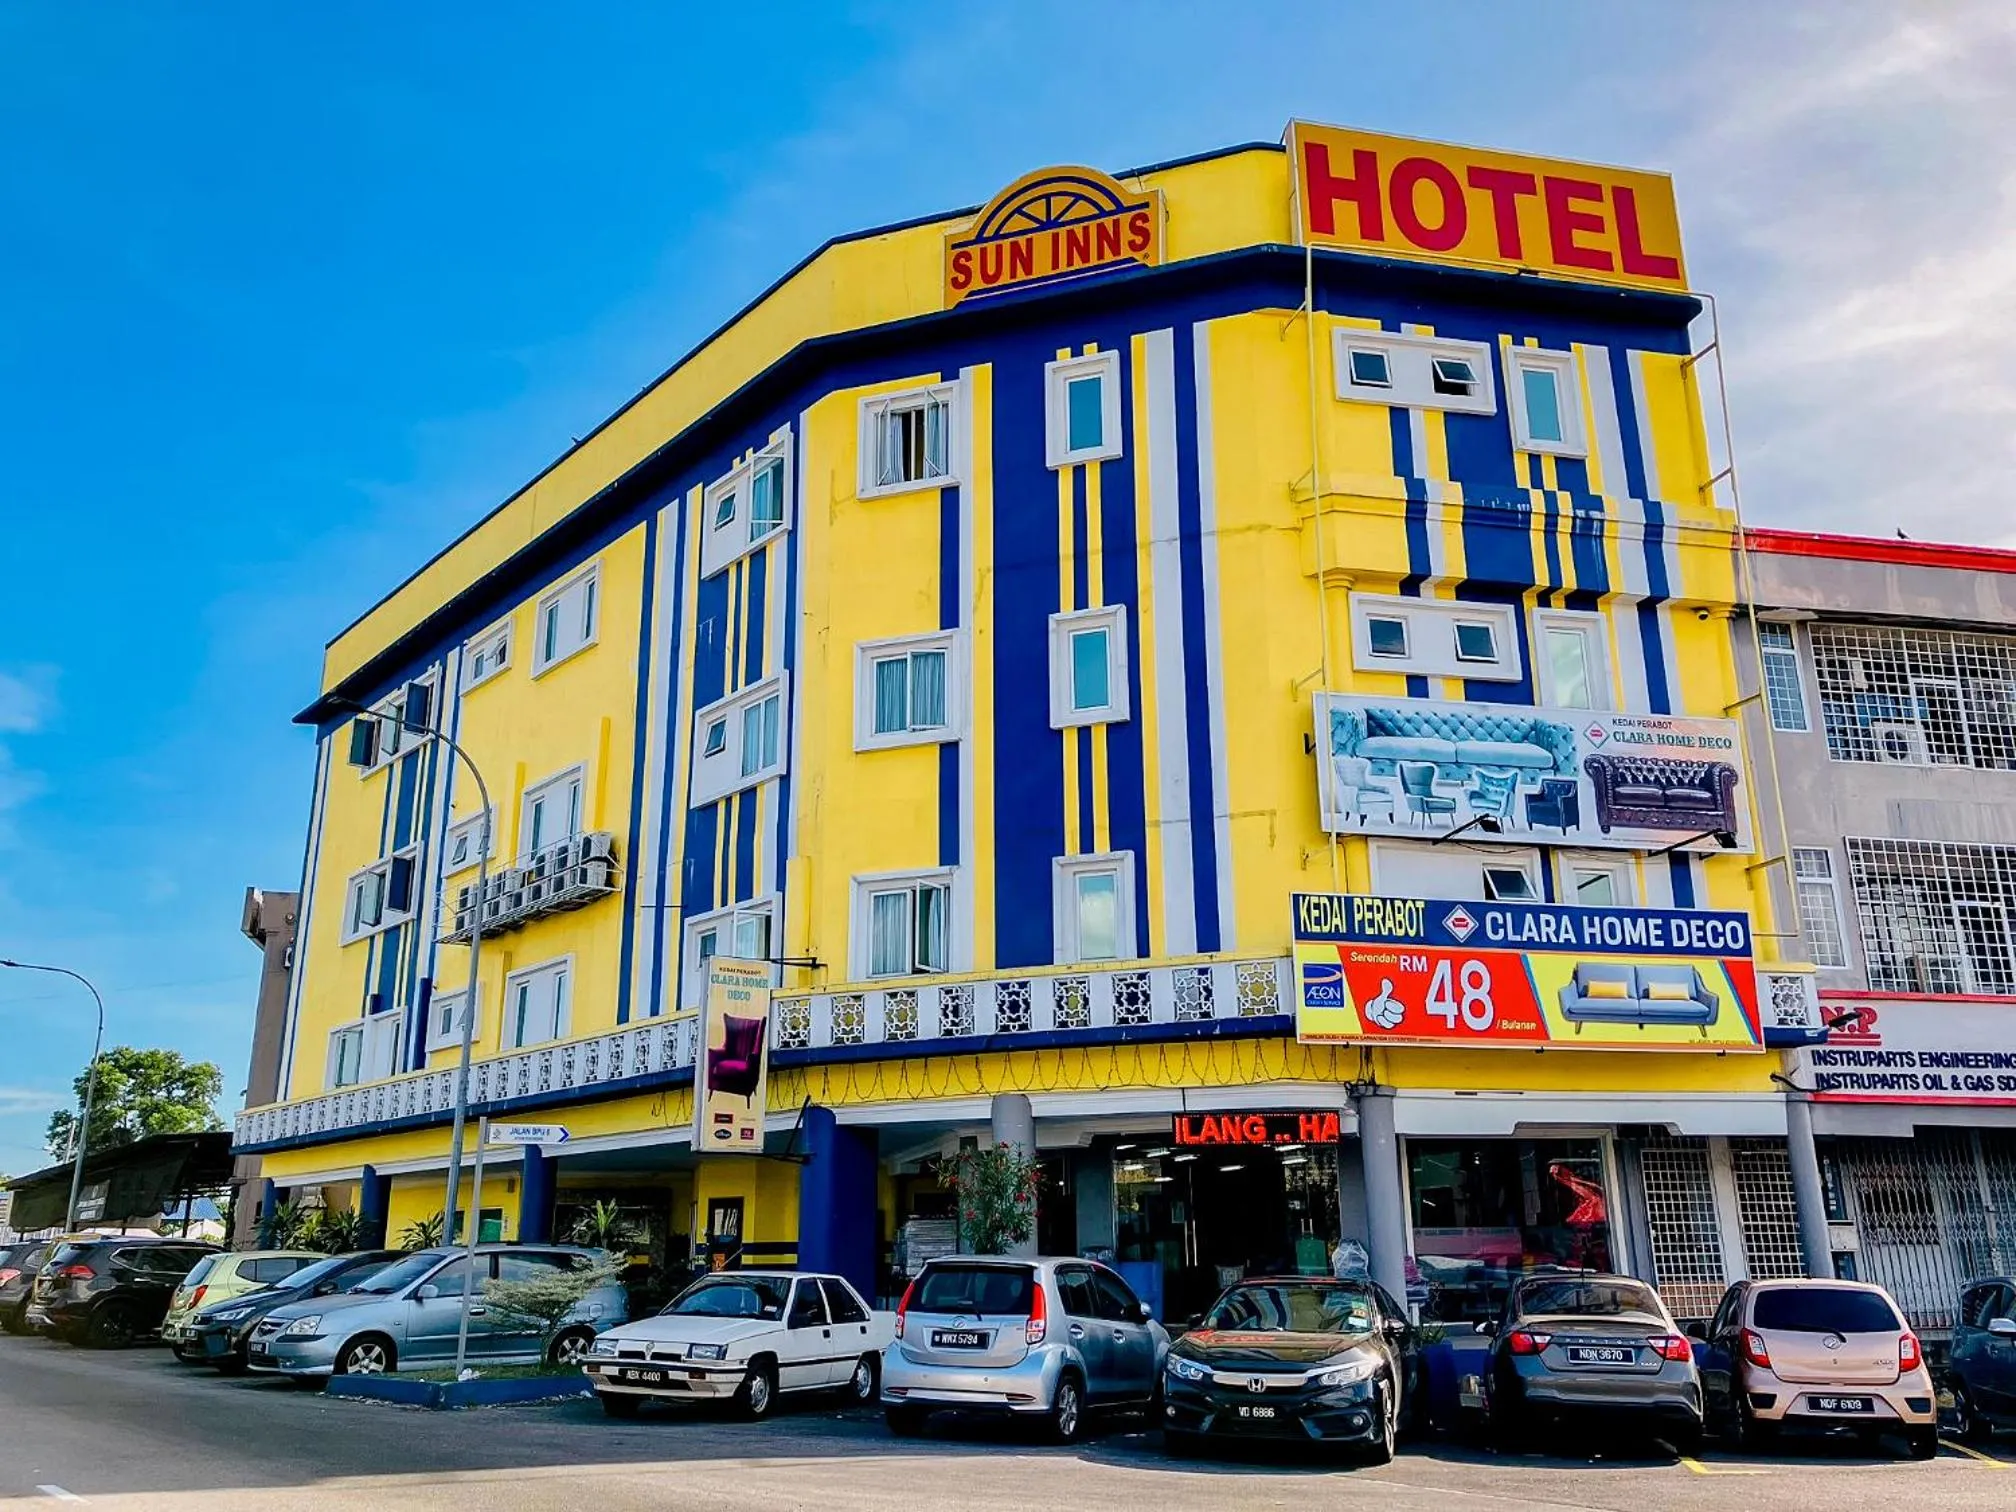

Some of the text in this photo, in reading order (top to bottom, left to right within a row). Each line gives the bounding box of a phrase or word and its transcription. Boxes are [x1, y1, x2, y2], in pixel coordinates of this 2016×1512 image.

[1304, 141, 1681, 280] HOTEL
[951, 212, 1151, 290] SUN INNS
[1612, 718, 1673, 729] KEDAI PERABOT
[1613, 731, 1732, 749] CLARA HOME DECO
[1300, 895, 1425, 937] KEDAI PERABOT
[1485, 911, 1745, 949] CLARA HOME DECO
[711, 974, 768, 988] CLARA HOME
[728, 990, 751, 1001] DECO
[1400, 954, 1494, 1031] RM 48
[1812, 1050, 1916, 1068] INSTRUPARTS
[1816, 1073, 1920, 1091] INSTRUPARTS
[1922, 1074, 1948, 1090] OIL
[1951, 1075, 1962, 1090] &
[1963, 1075, 1995, 1091] GAS
[510, 1127, 530, 1135] JALAN
[1599, 1350, 1623, 1361] 3670
[642, 1371, 661, 1381] 4400
